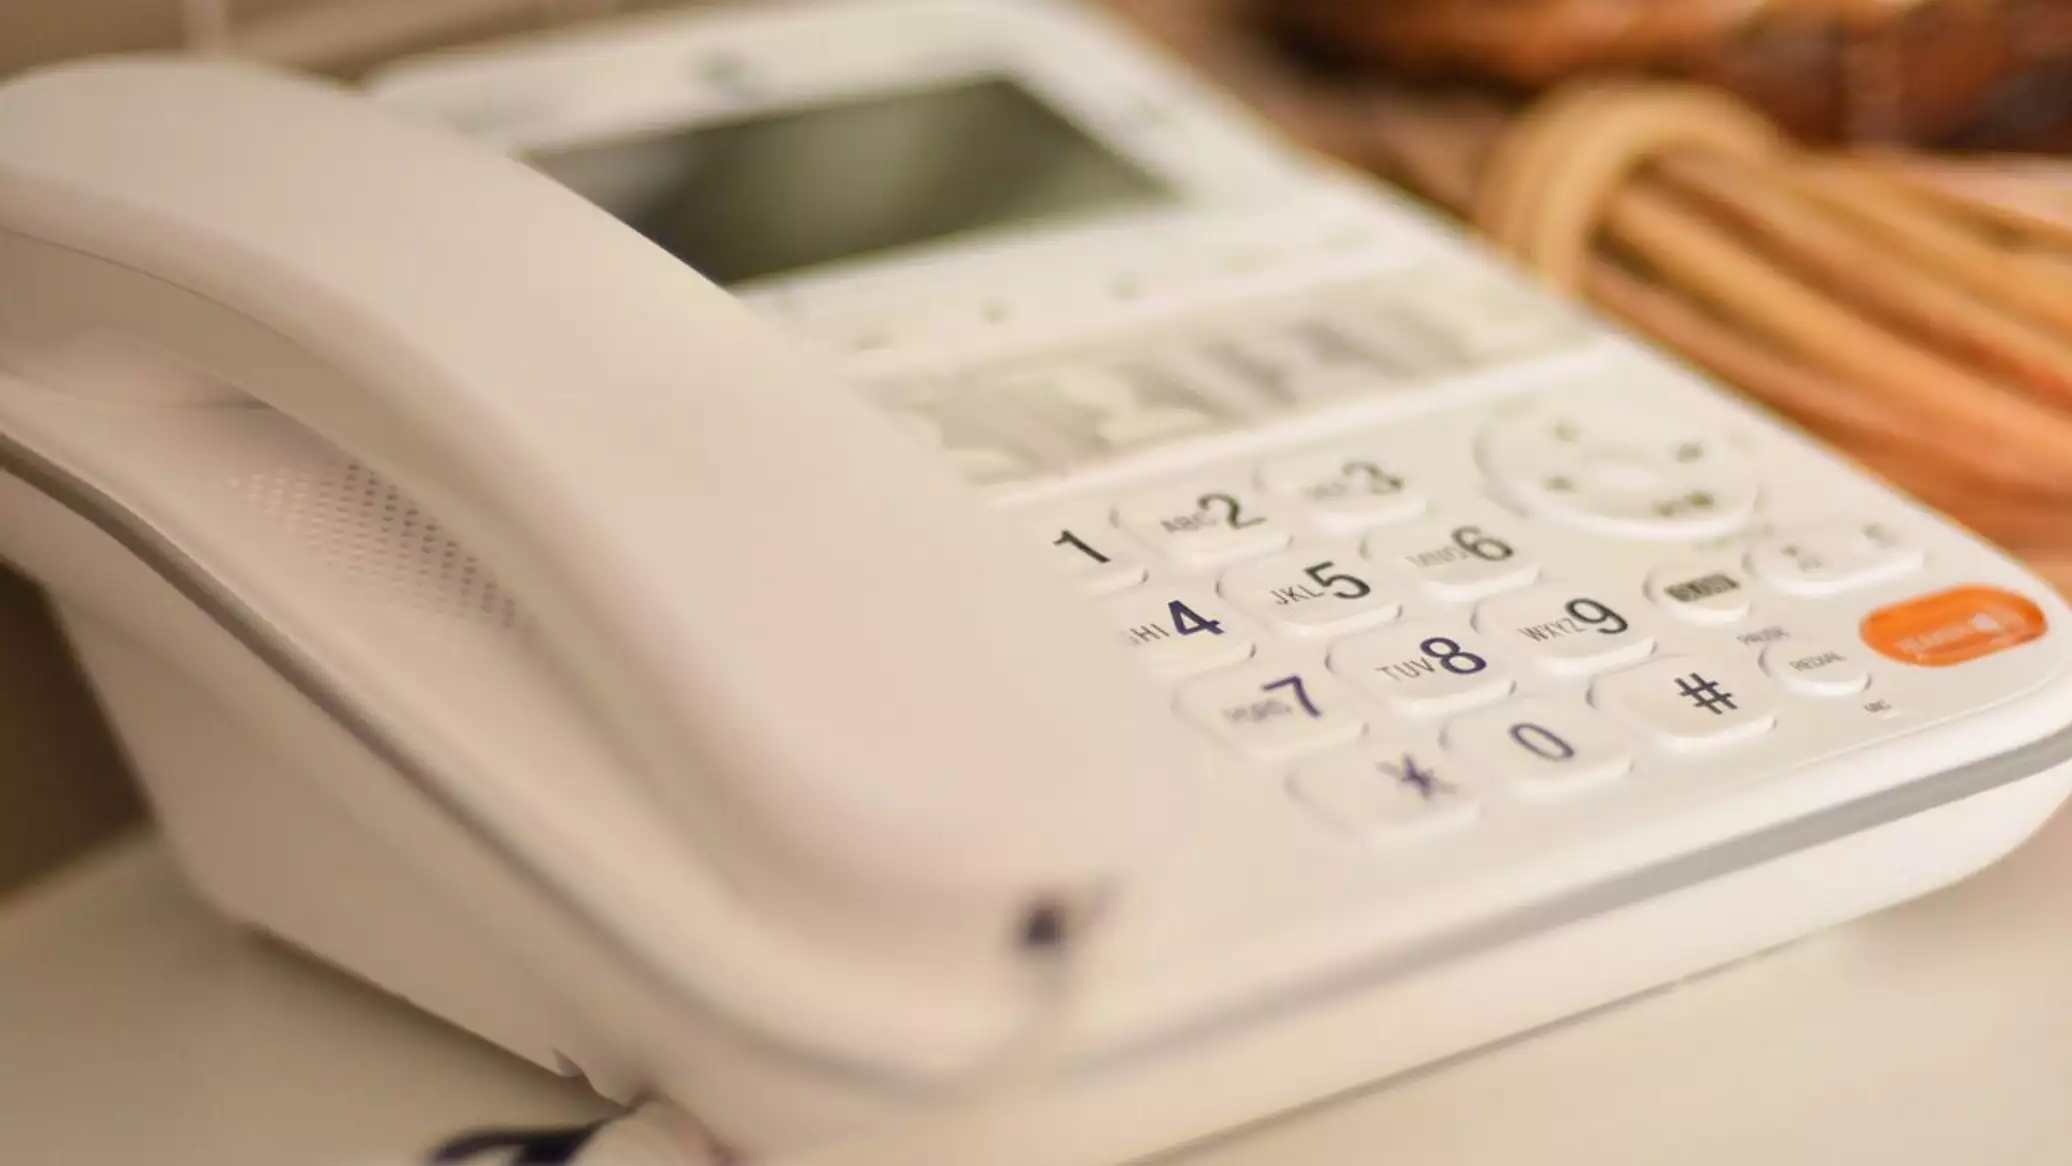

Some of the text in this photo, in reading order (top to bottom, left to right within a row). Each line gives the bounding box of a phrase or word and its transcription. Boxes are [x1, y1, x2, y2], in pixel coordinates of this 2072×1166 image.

[1196, 493, 1267, 530] 2
[1053, 530, 1111, 564] 1
[1451, 525, 1514, 562] 6
[1271, 560, 1371, 605] JKL 5
[1167, 600, 1225, 636] 4
[1516, 597, 1628, 642] WXYZ 9
[1374, 636, 1487, 682] TUV 8
[1260, 675, 1322, 718] 7
[1673, 672, 1739, 715] #
[1508, 721, 1576, 762] 0
